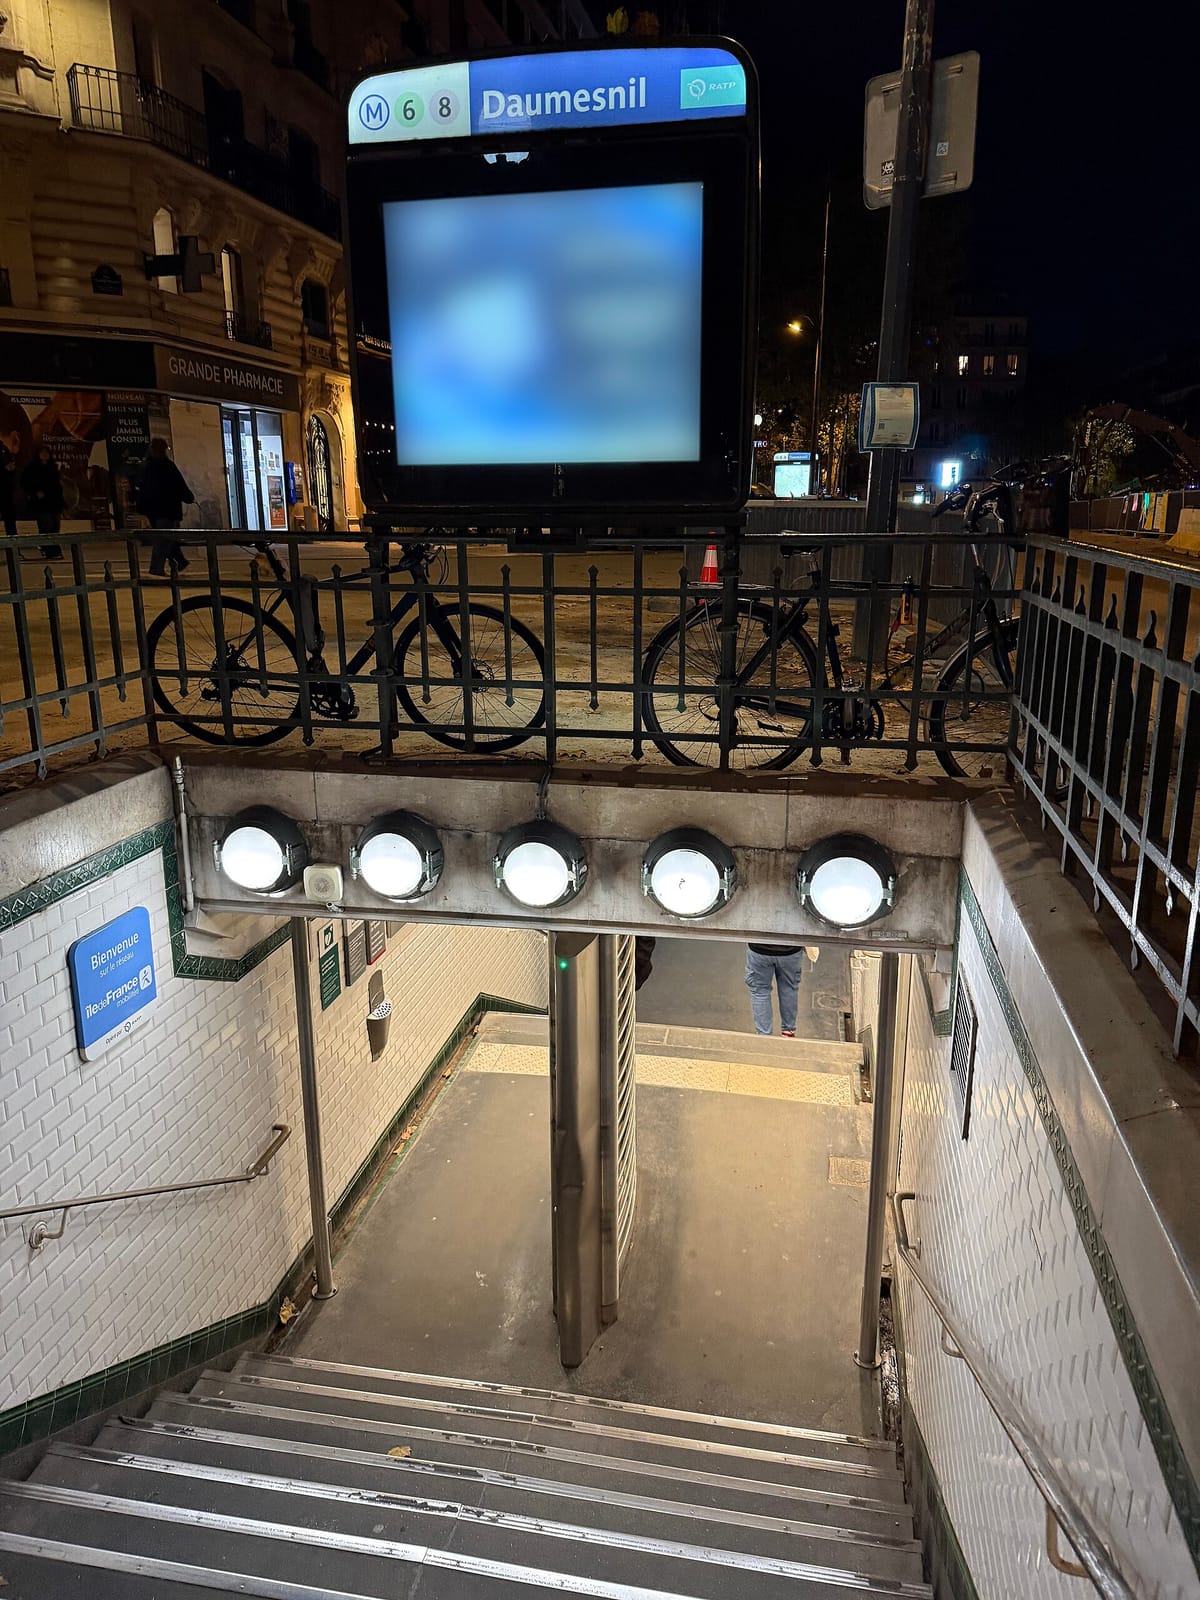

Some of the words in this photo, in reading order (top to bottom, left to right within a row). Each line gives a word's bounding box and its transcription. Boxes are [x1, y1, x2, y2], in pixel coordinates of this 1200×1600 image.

[708, 81, 737, 91] RATP
[402, 99, 416, 121] 6
[438, 96, 452, 118] 8
[483, 76, 646, 120] Daumesnil
[168, 356, 220, 383] GRANDE
[223, 367, 284, 395] PHARMACIE
[115, 426, 143, 435] JAMAIS
[119, 418, 139, 426] PLUS
[753, 440, 768, 448] TRO
[90, 932, 139, 970] Bienvenue
[99, 966, 109, 978] sur
[116, 951, 134, 968] réseau
